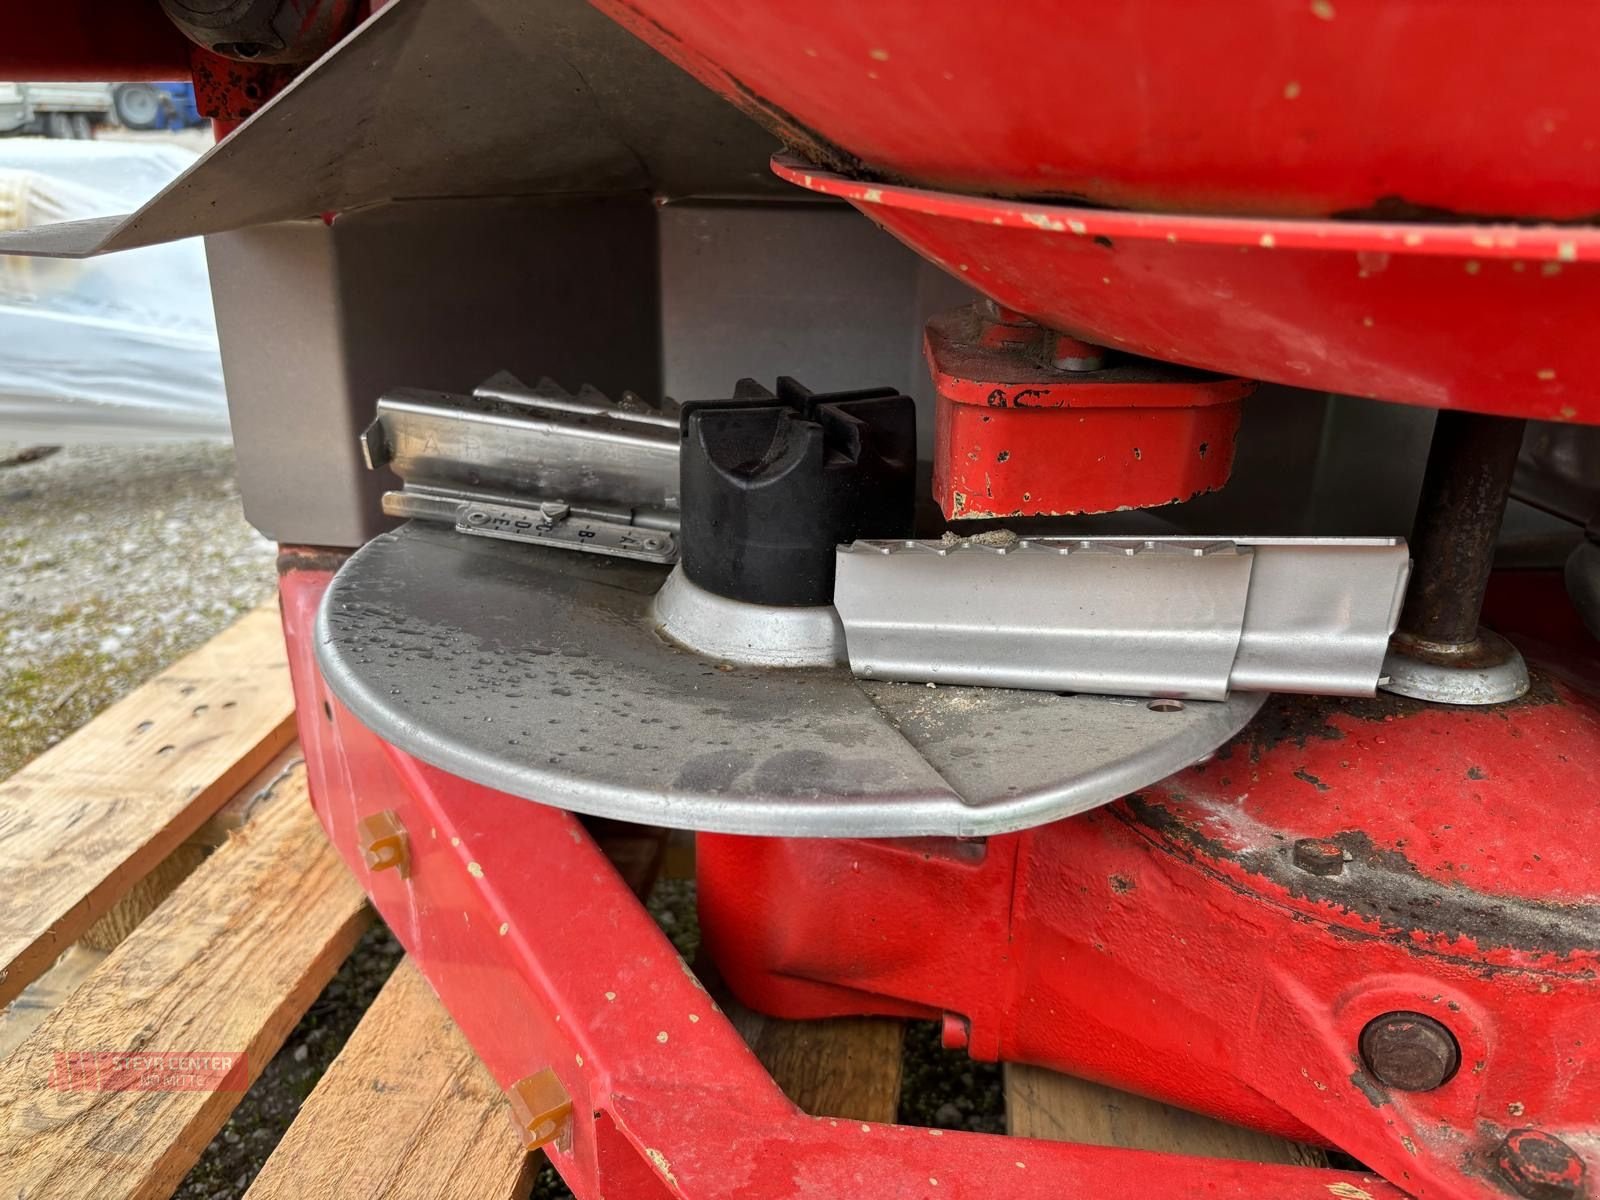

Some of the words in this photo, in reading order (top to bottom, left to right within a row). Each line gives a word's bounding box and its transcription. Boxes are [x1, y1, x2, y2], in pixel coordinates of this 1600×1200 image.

[492, 518, 510, 526] E
[514, 521, 532, 529] D
[536, 523, 553, 533] C
[578, 530, 595, 538] B
[619, 535, 635, 544] A
